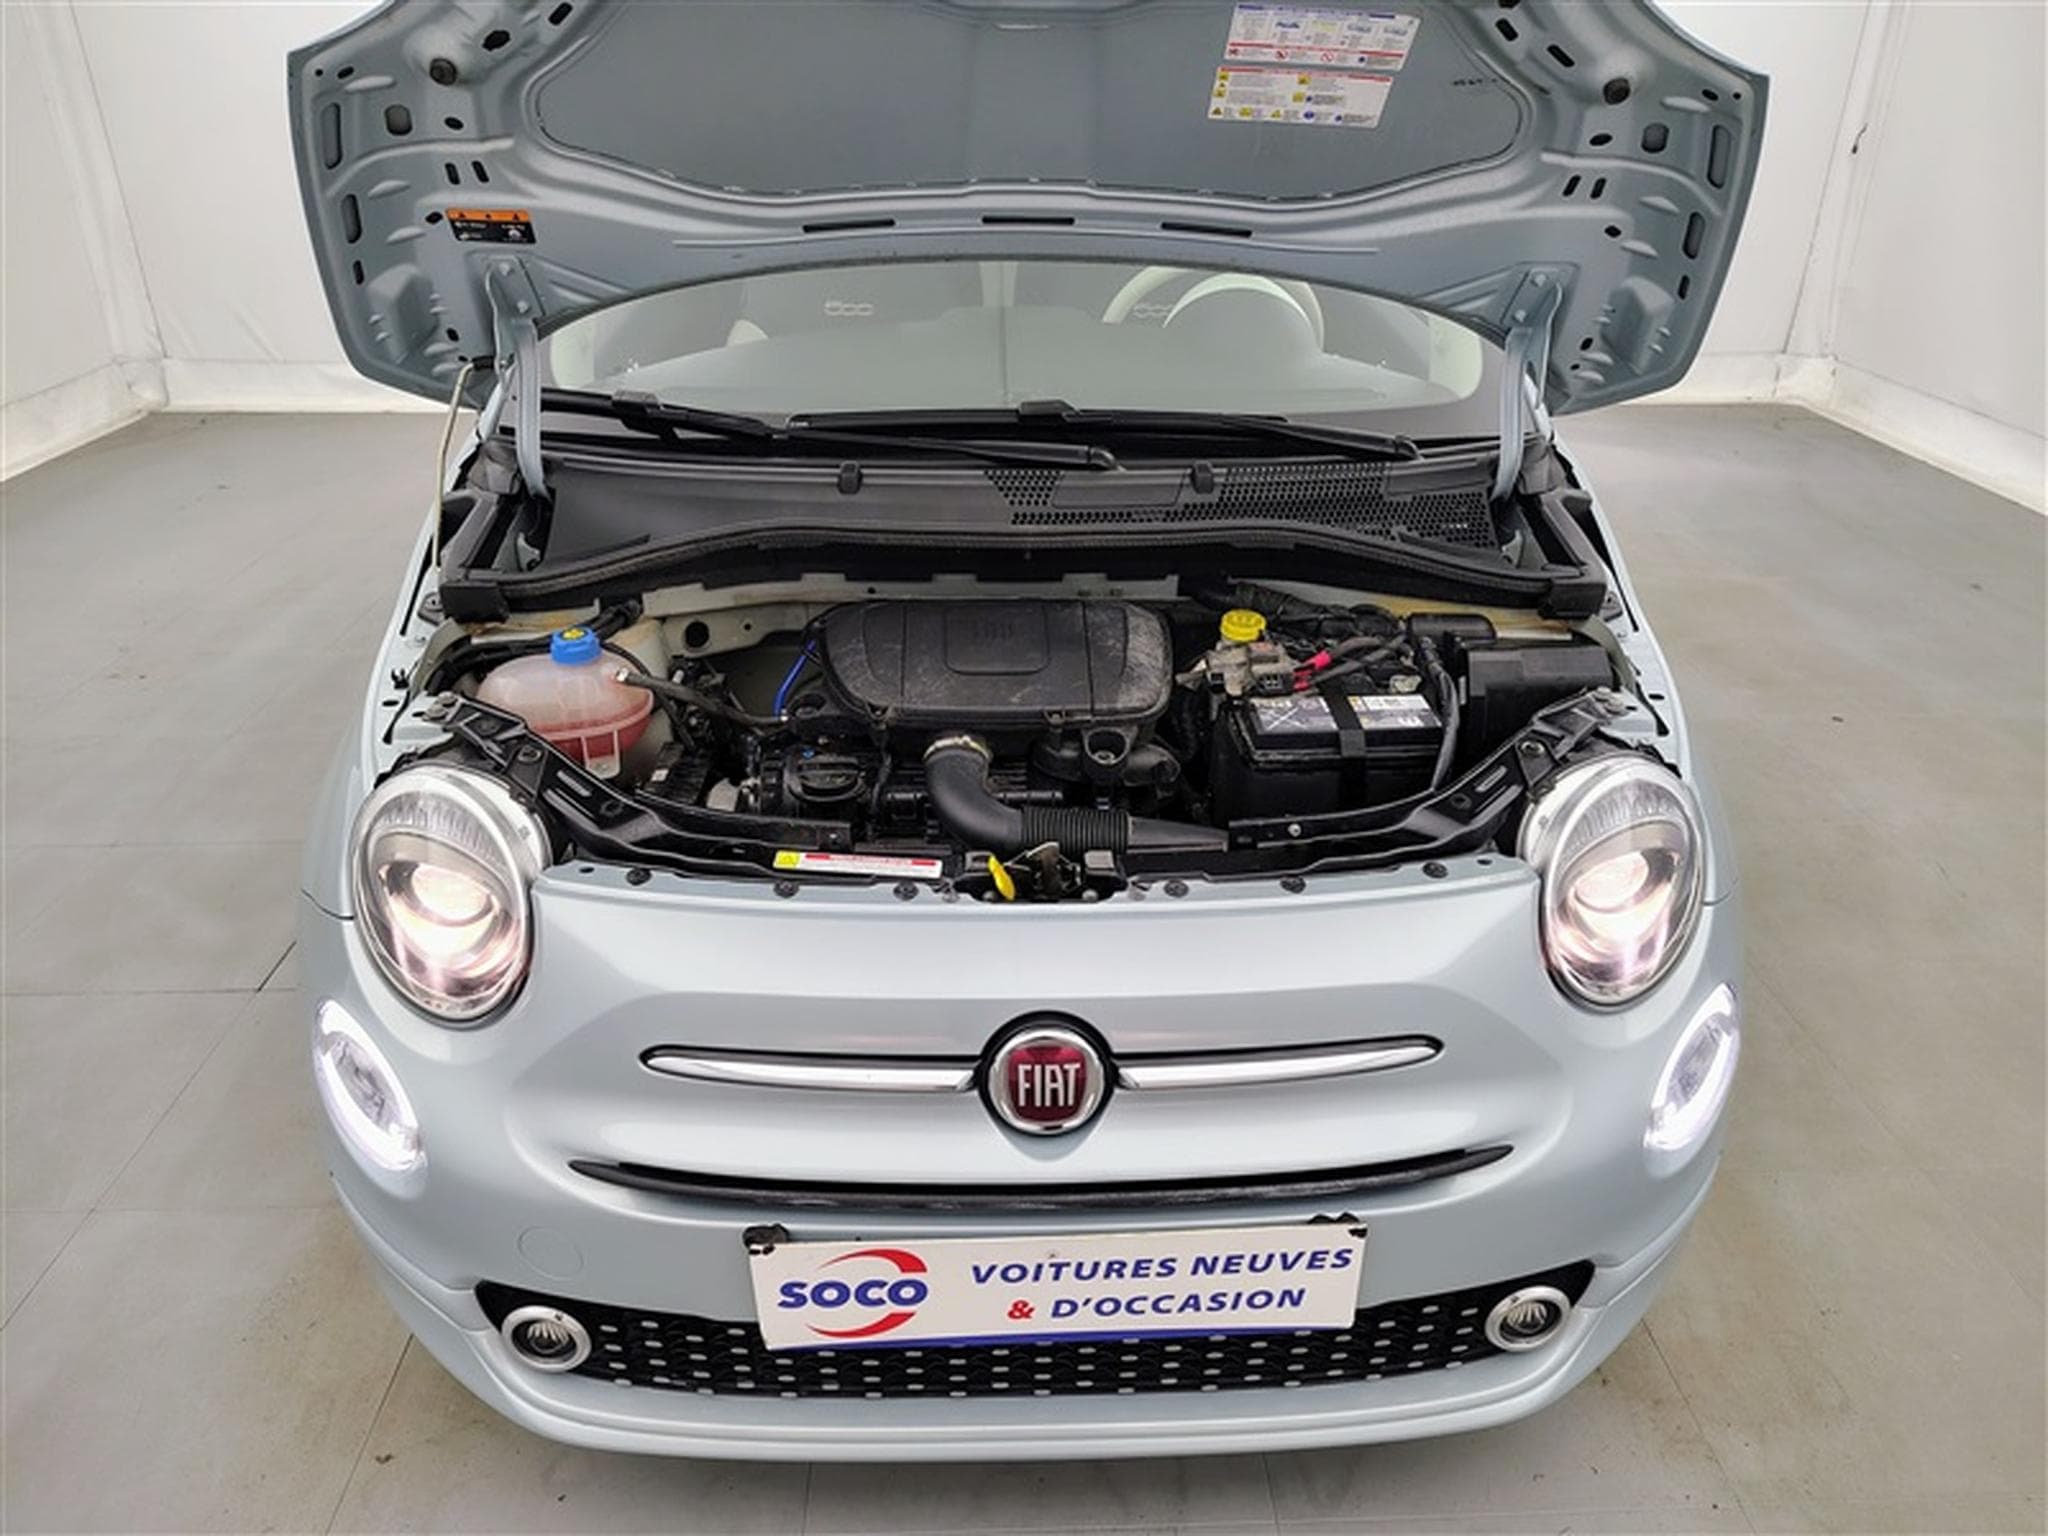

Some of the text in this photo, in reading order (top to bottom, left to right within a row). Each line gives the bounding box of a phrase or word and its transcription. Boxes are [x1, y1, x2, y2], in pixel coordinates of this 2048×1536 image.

[1018, 1064, 1080, 1107] FIAT
[972, 1248, 1354, 1284] VOITURES NEUVES
[777, 1278, 929, 1309] SOCO
[1007, 1288, 1306, 1320] & D'OCCASION
